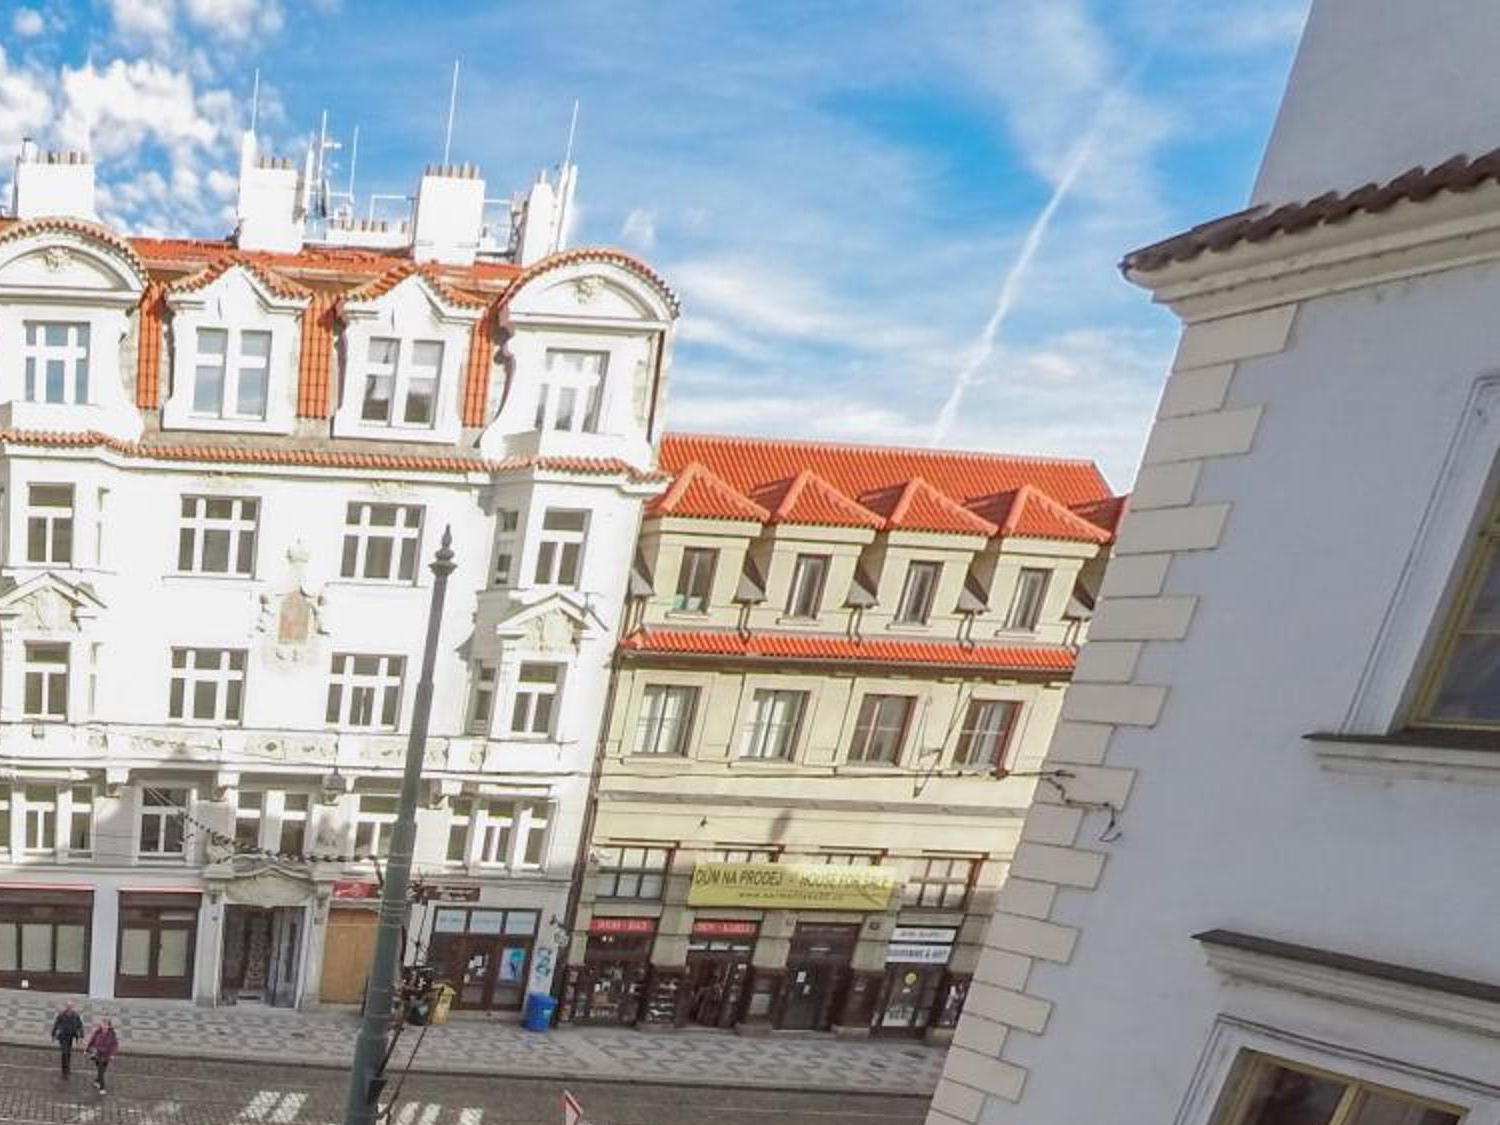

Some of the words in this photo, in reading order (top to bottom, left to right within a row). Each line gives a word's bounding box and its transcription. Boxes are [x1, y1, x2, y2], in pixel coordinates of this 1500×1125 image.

[695, 866, 721, 885] DŮM
[722, 870, 738, 885] NA
[739, 869, 784, 887] PRODEJ
